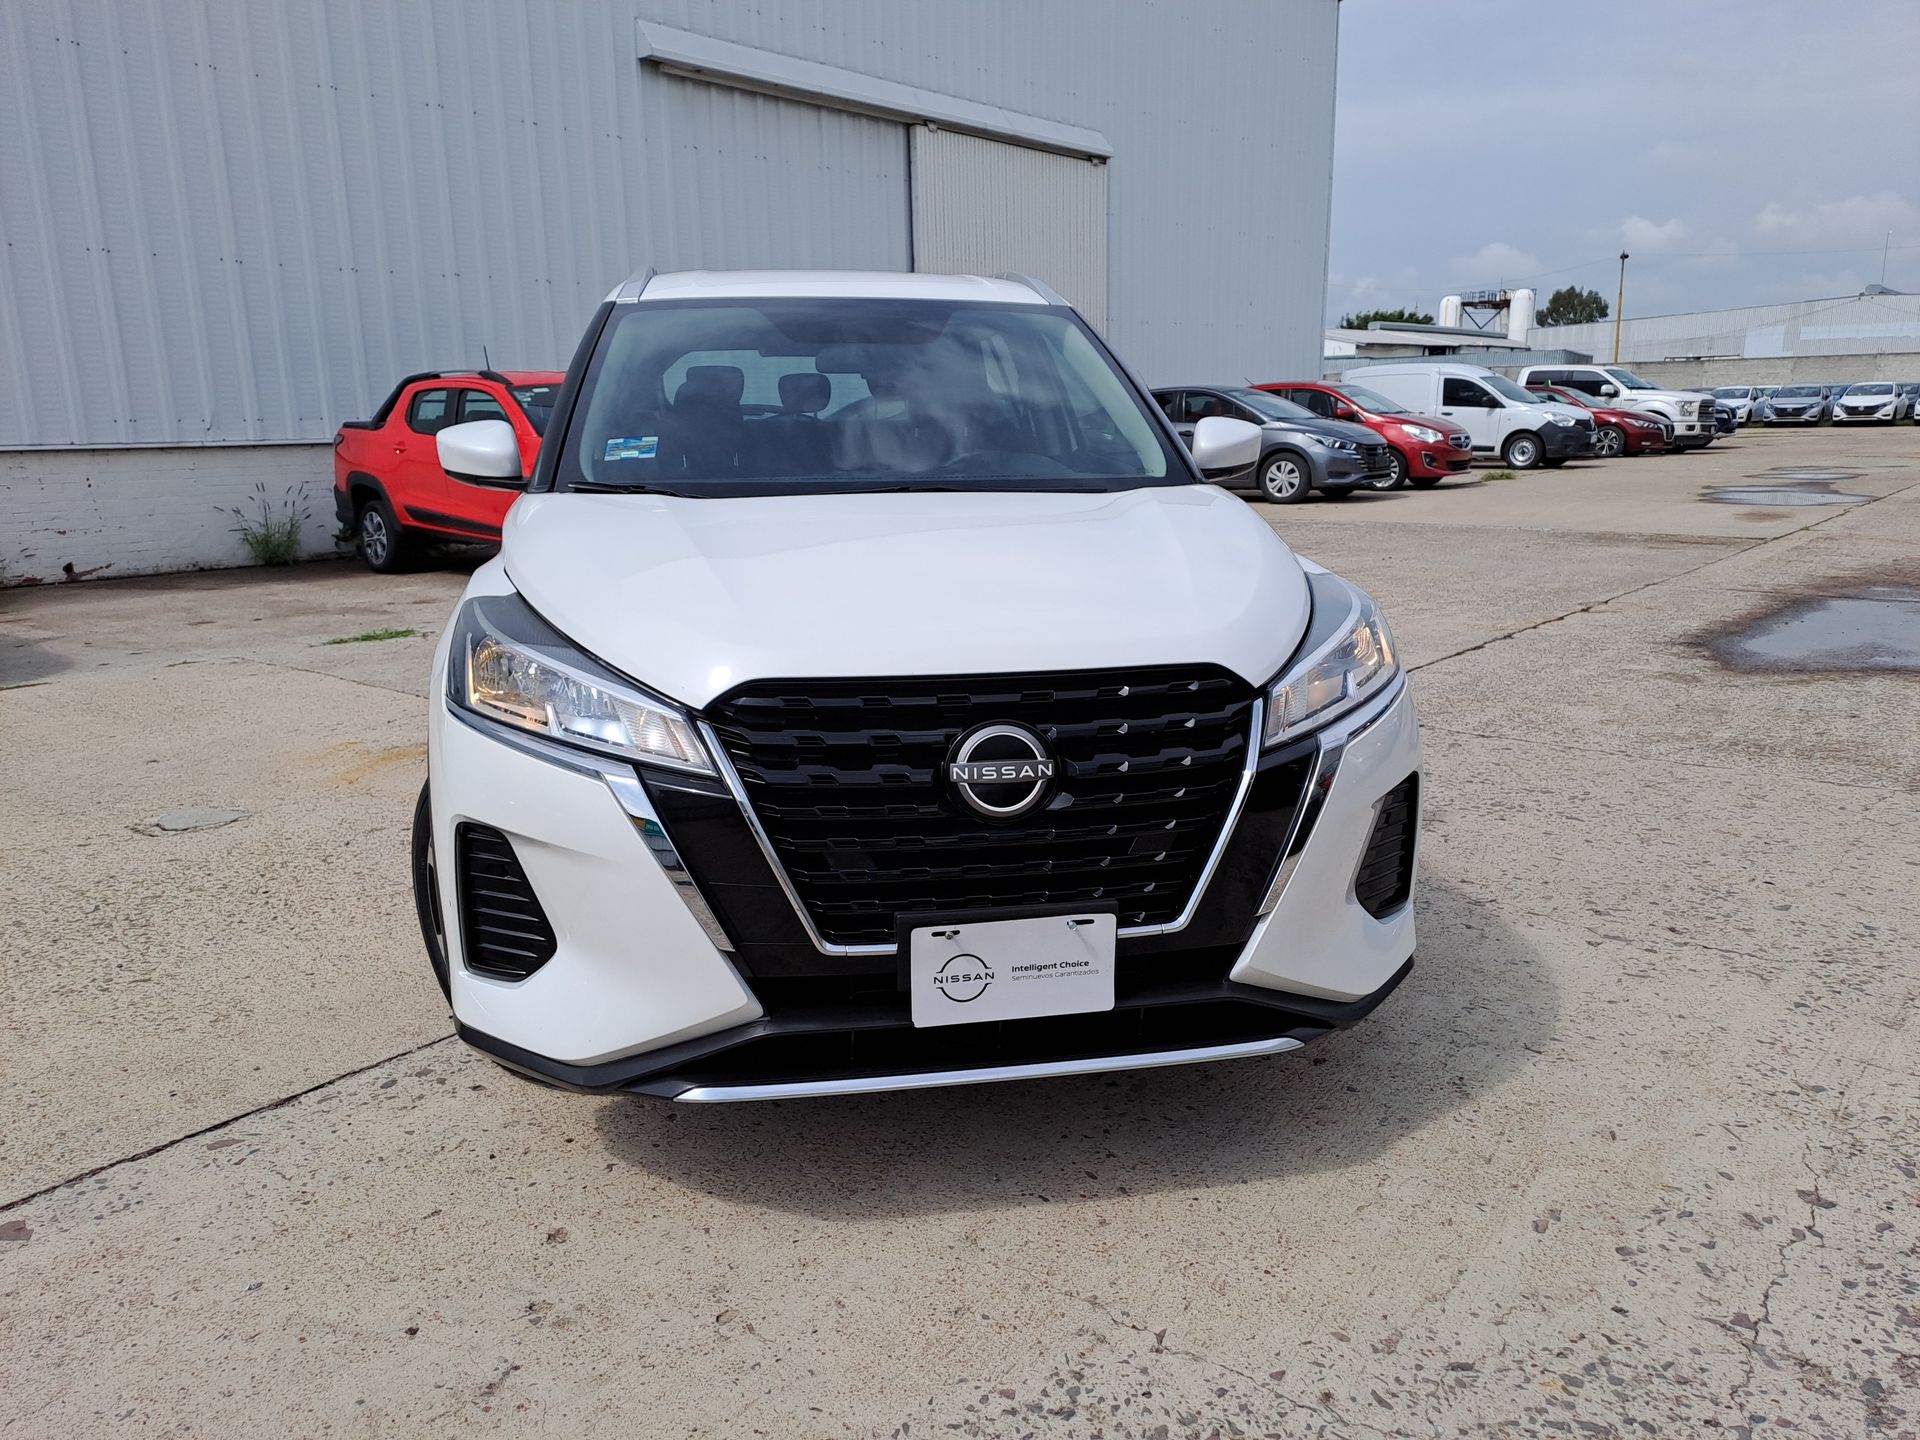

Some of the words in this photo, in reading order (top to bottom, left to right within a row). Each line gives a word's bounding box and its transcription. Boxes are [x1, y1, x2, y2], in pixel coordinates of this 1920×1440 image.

[953, 764, 1052, 779] NISSAN
[1011, 963, 1057, 973] Intelligent
[1059, 960, 1090, 969] Choice
[933, 972, 995, 984] NISSAN
[1011, 973, 1053, 982] Seminuevos
[1054, 968, 1099, 978] Garantizados
